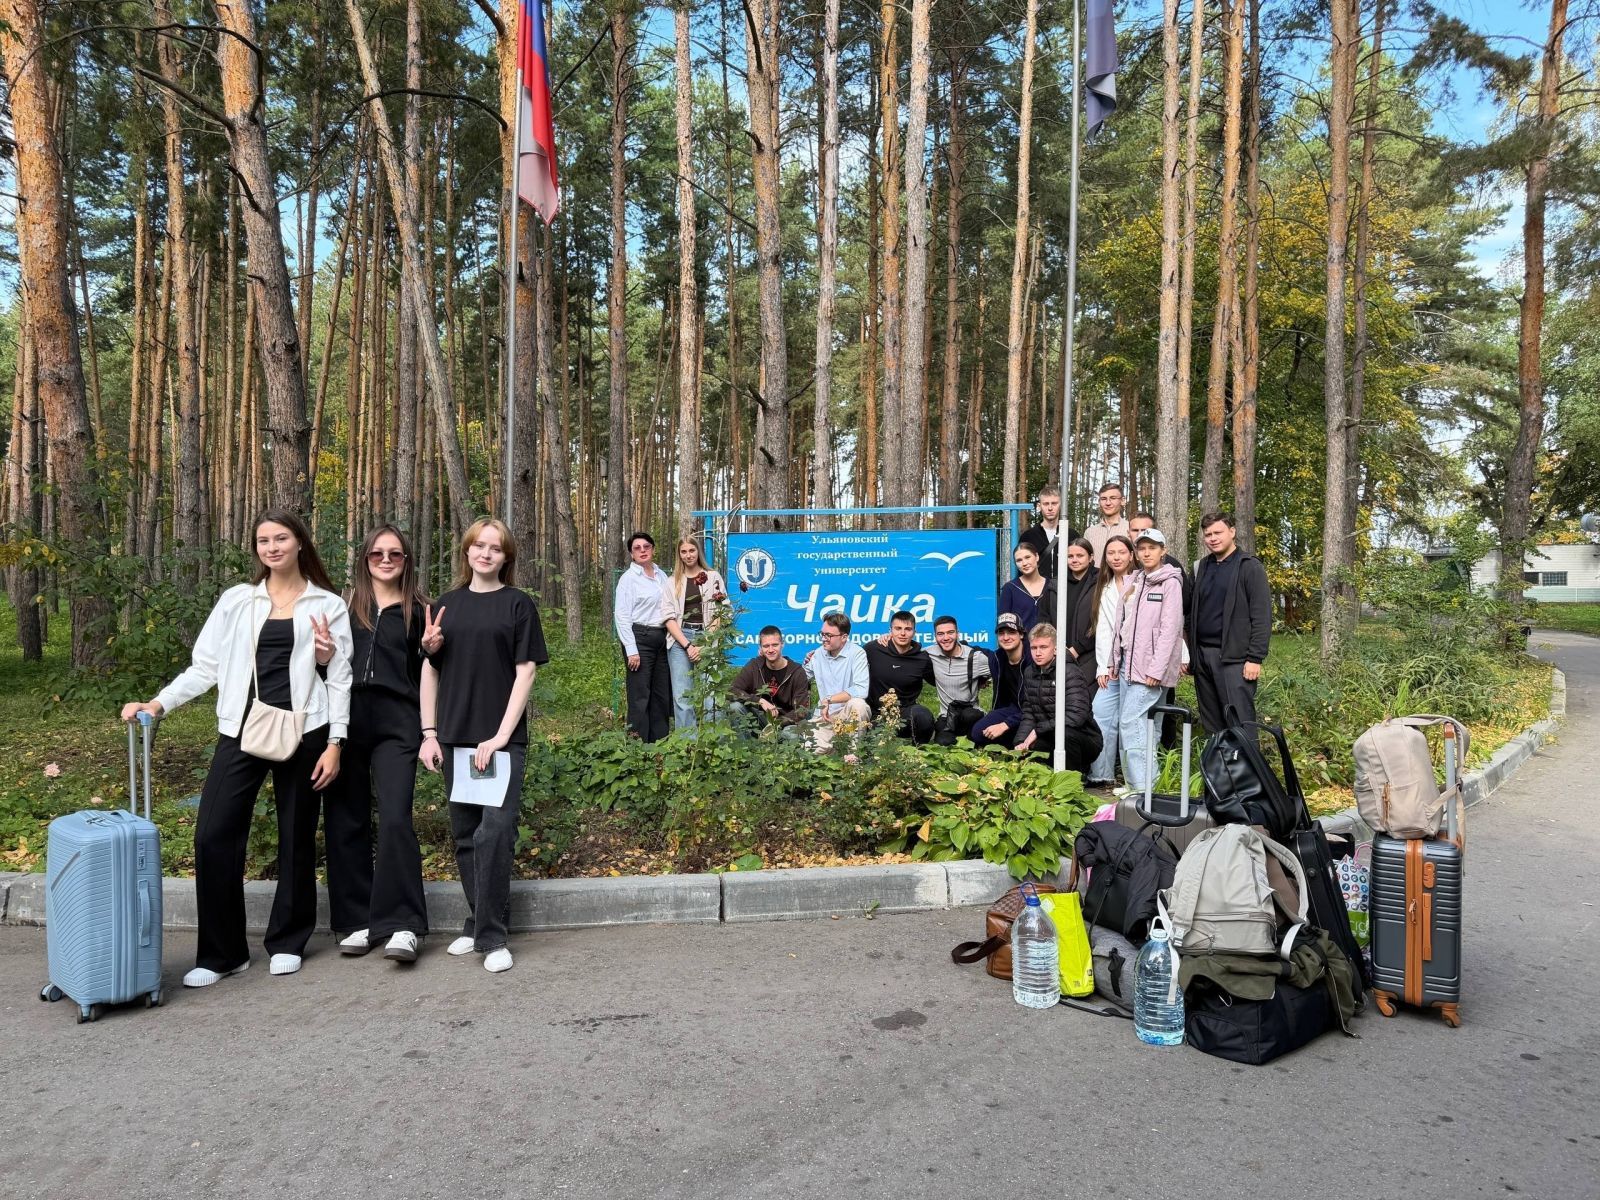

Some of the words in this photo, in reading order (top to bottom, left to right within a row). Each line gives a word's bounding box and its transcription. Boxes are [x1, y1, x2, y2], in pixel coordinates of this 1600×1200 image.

[811, 533, 889, 545] Ульяновский
[797, 548, 898, 561] государственный
[813, 566, 888, 577] университет
[787, 583, 936, 623] Чайка
